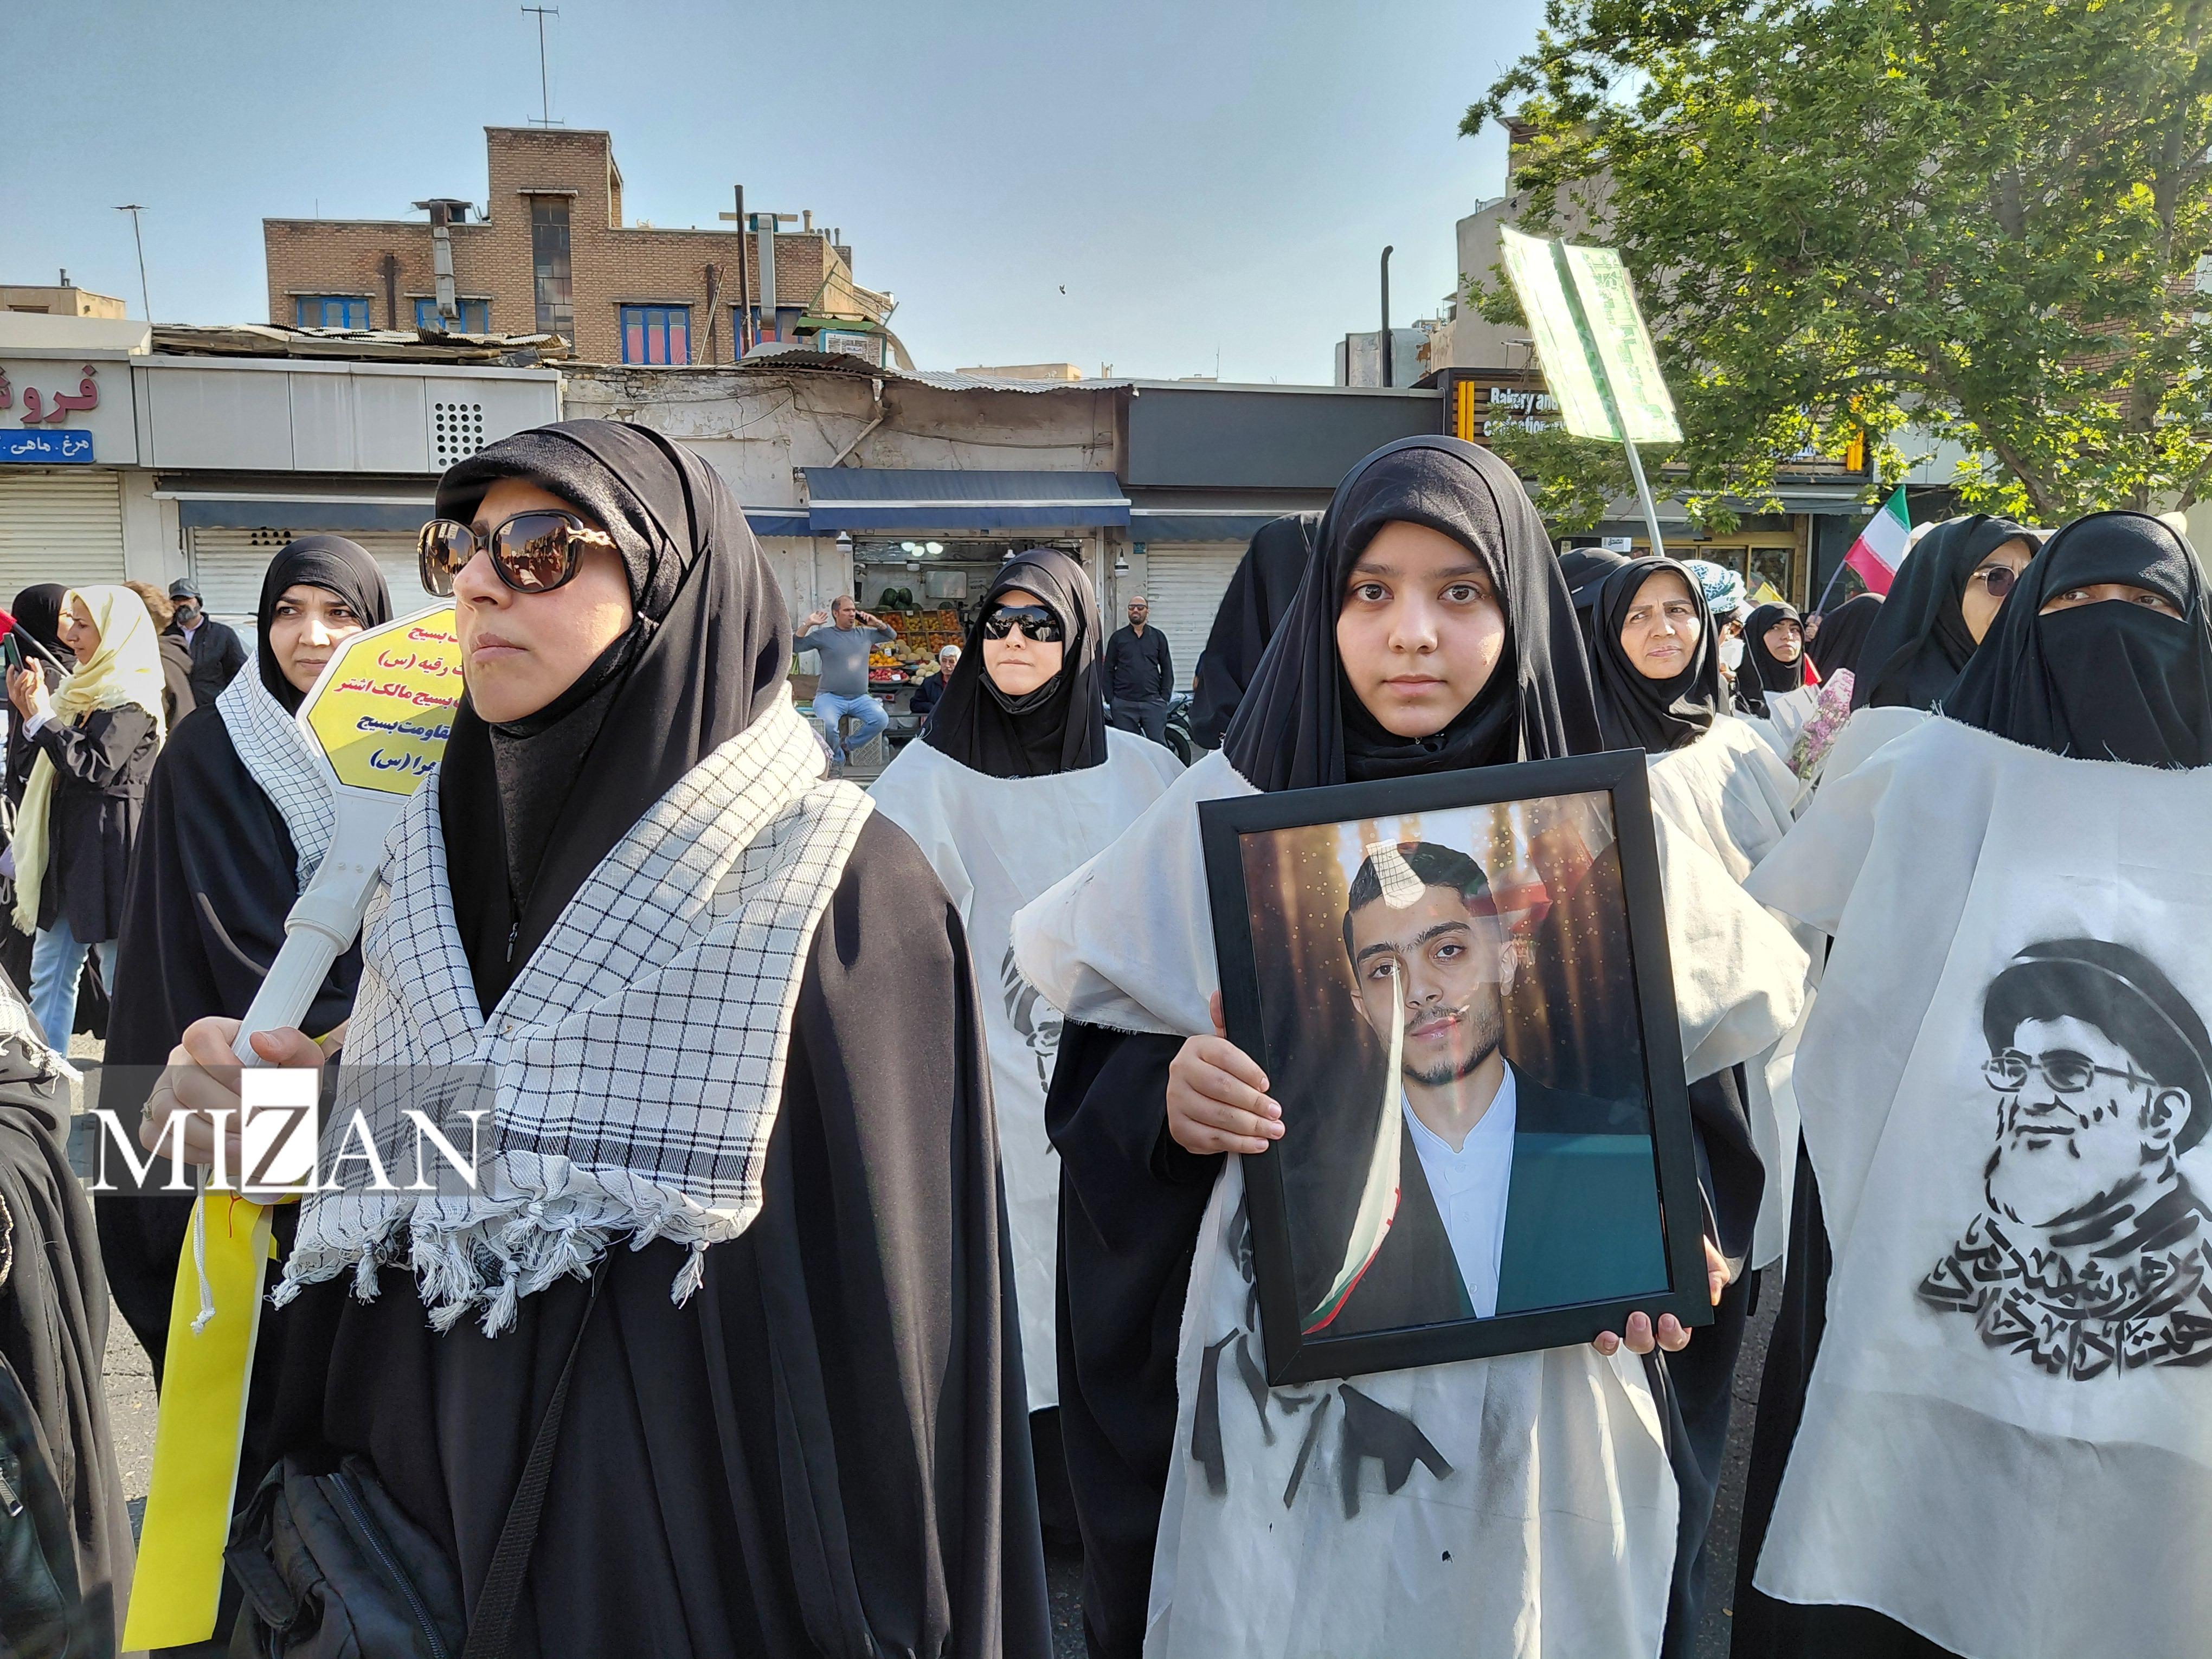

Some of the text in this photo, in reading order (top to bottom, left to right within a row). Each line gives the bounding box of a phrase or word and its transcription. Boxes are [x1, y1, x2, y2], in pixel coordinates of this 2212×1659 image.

[0, 364, 99, 423] فرو
[10, 435, 89, 456] مرغ ماهی
[408, 627, 447, 644] بسیج
[418, 657, 448, 677] رقیه
[333, 678, 374, 692] اشتر
[372, 683, 412, 699] مالک
[412, 692, 453, 709] بسیج
[356, 716, 451, 741] قاومت بسیج
